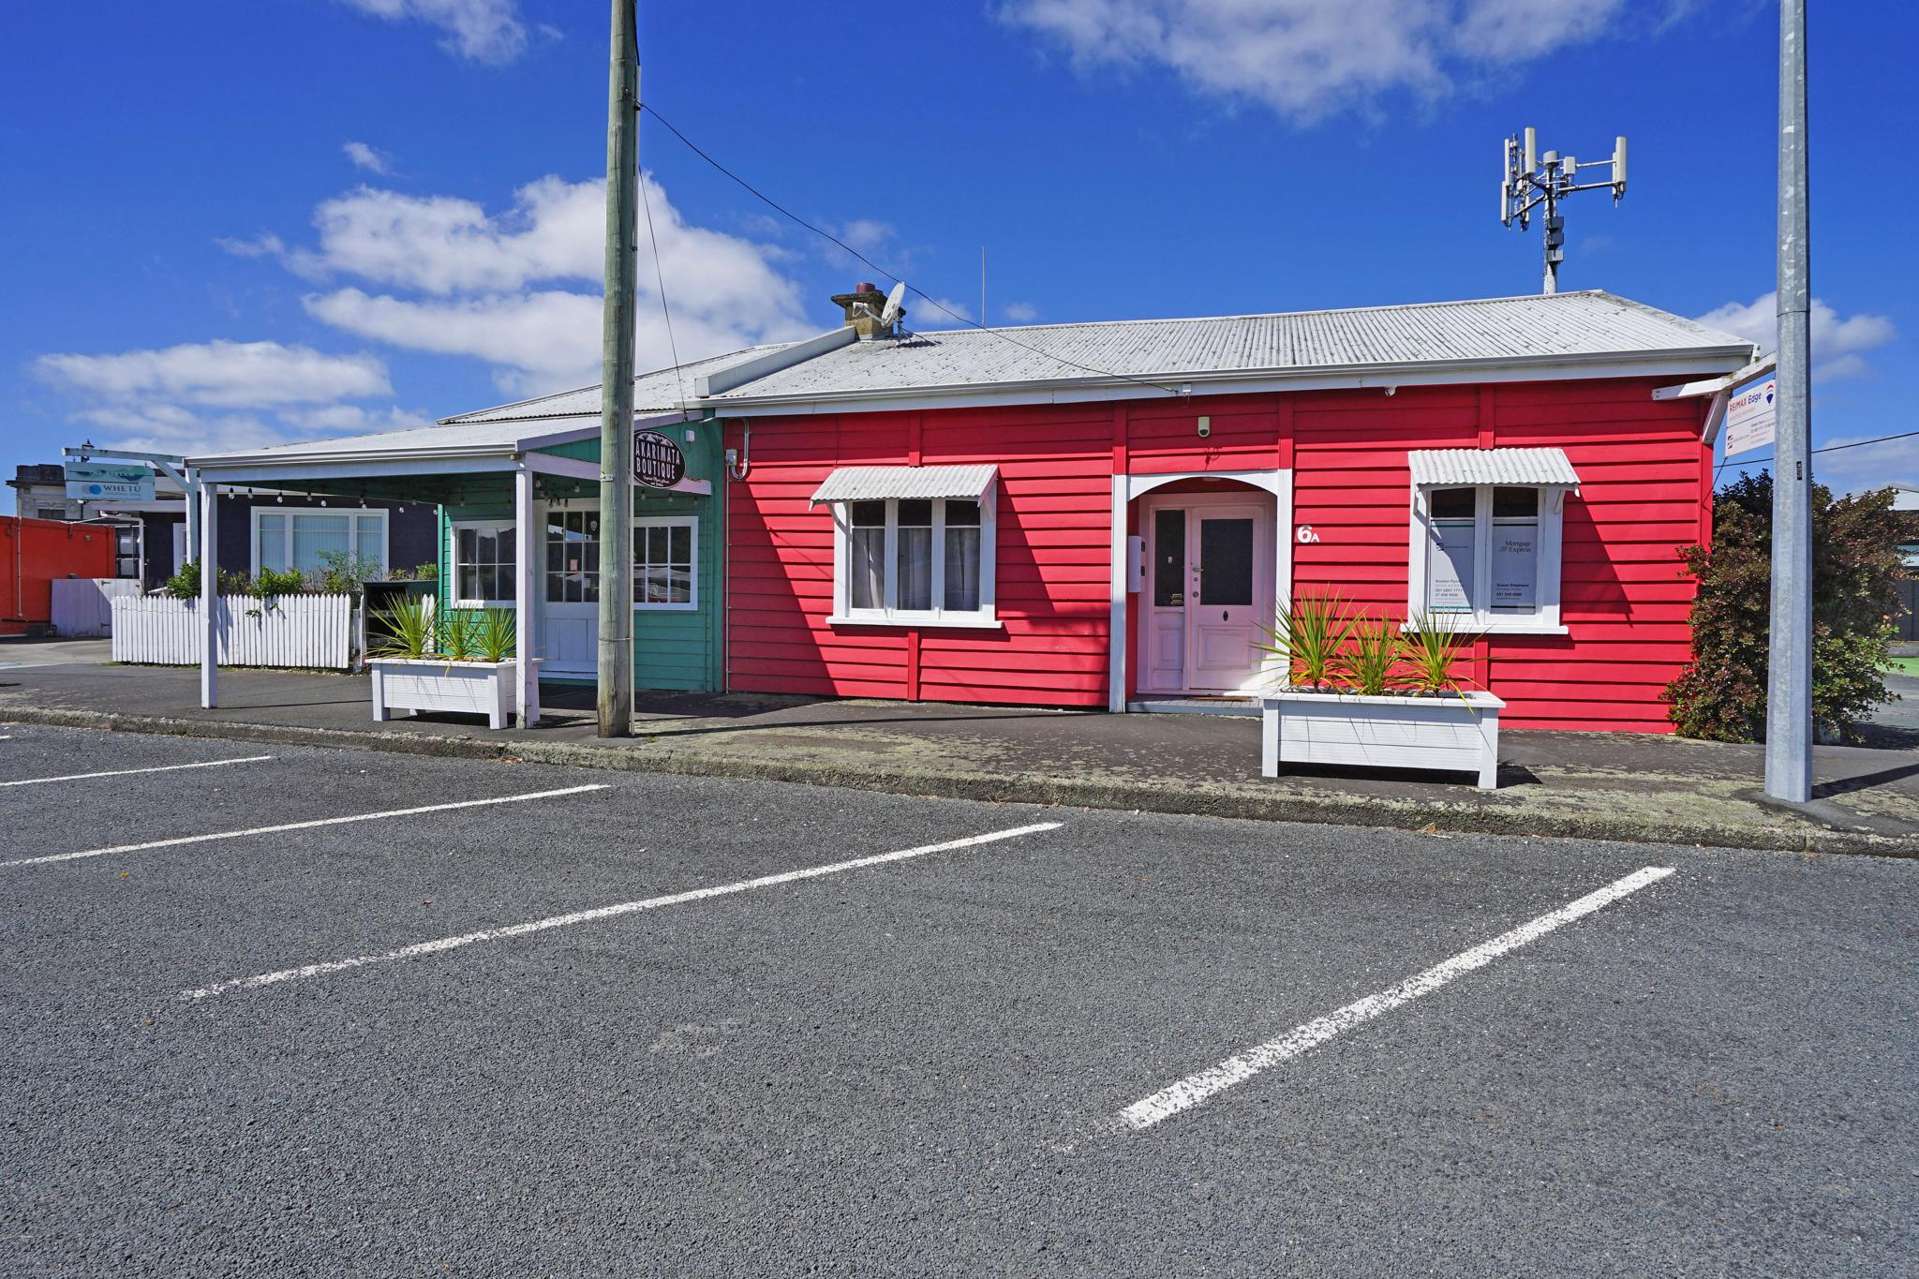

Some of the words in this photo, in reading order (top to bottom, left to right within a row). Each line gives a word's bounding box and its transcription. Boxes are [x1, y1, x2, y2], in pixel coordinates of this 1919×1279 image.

[1747, 391, 1762, 405] Edge
[634, 439, 681, 465] AKARIMATA
[636, 456, 676, 480] BOUTIQUE
[1297, 525, 1320, 543] 6A
